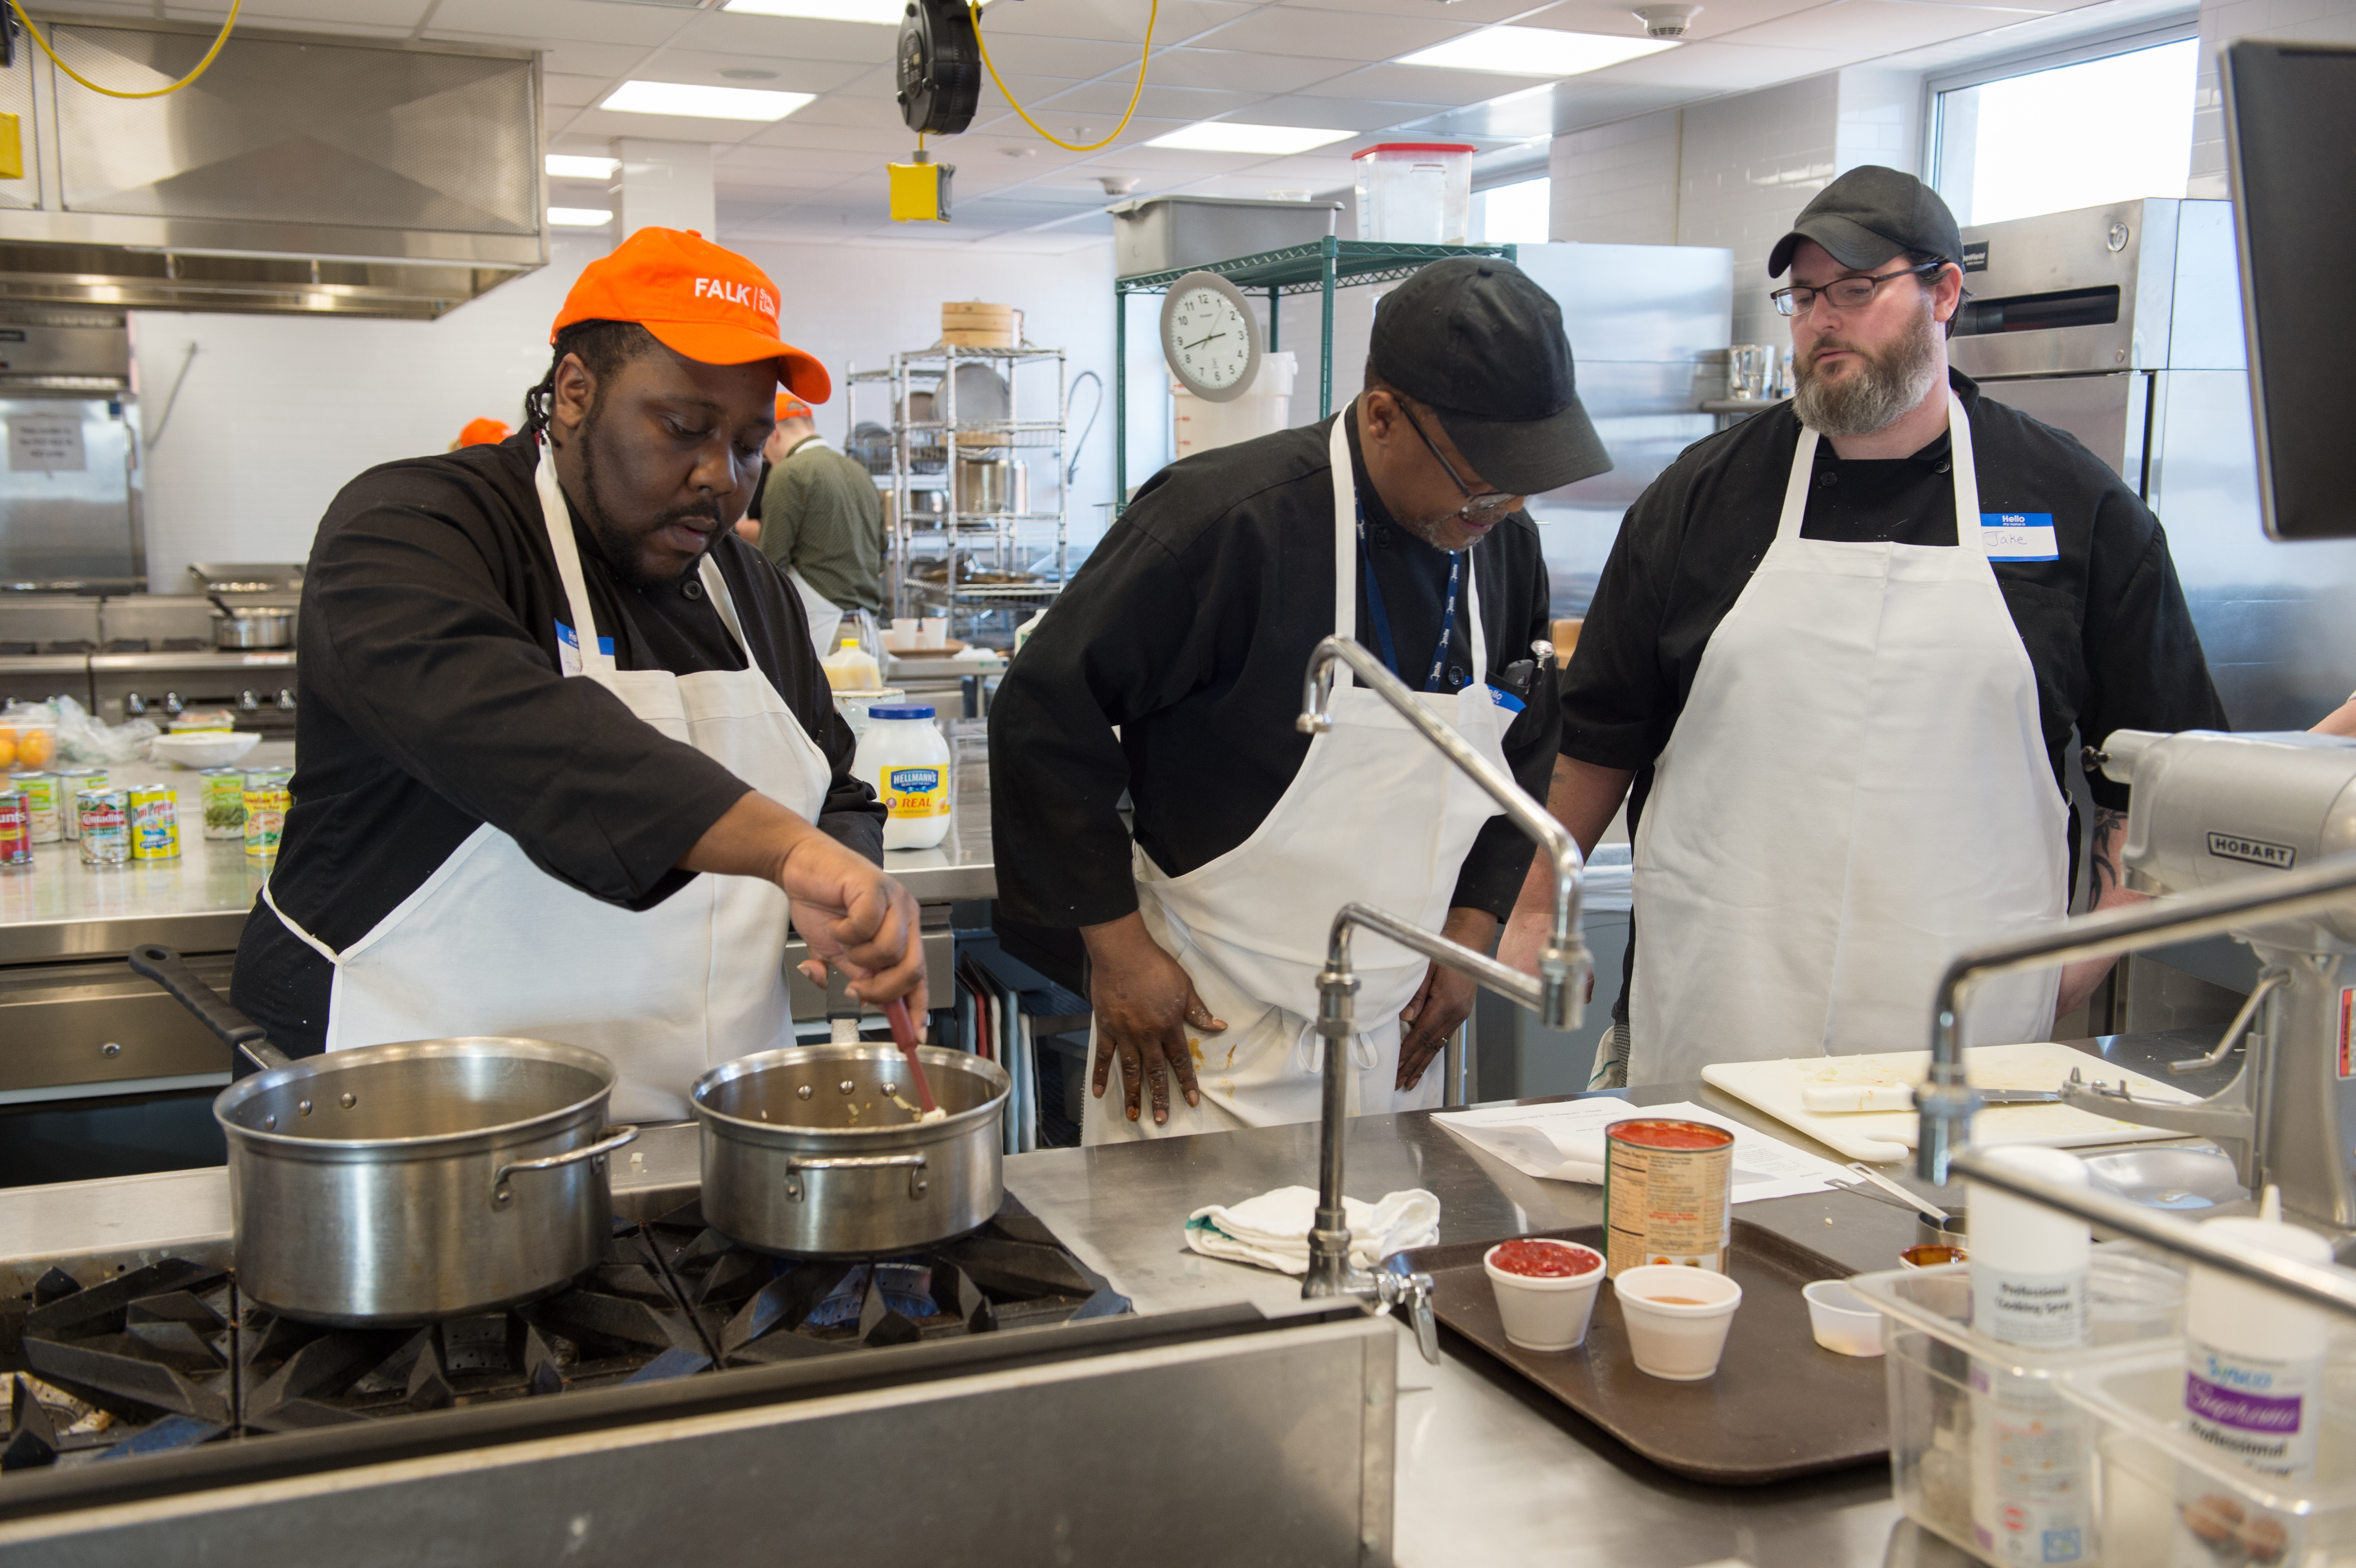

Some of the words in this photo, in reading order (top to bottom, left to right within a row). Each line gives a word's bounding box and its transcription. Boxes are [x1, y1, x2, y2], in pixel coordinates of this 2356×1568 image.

[695, 278, 752, 307] FALK
[1198, 294, 1209, 304] 12
[1217, 298, 1222, 308] 1
[1184, 302, 1194, 311] 11
[1178, 316, 1188, 326] 10
[1230, 311, 1236, 321] 2
[1238, 330, 1244, 340] 3
[1177, 336, 1183, 346] 9
[1185, 354, 1191, 364] 8
[1237, 349, 1243, 359] 4
[1199, 367, 1205, 377] 7
[1229, 364, 1235, 374] 5
[1215, 371, 1221, 381] 6
[1984, 531, 2027, 546] Jake
[894, 771, 937, 784] HELLMANN'S
[902, 798, 931, 807] REAL
[83, 813, 123, 825] Contadina
[132, 808, 147, 822] Don
[2215, 838, 2288, 862] HOBART
